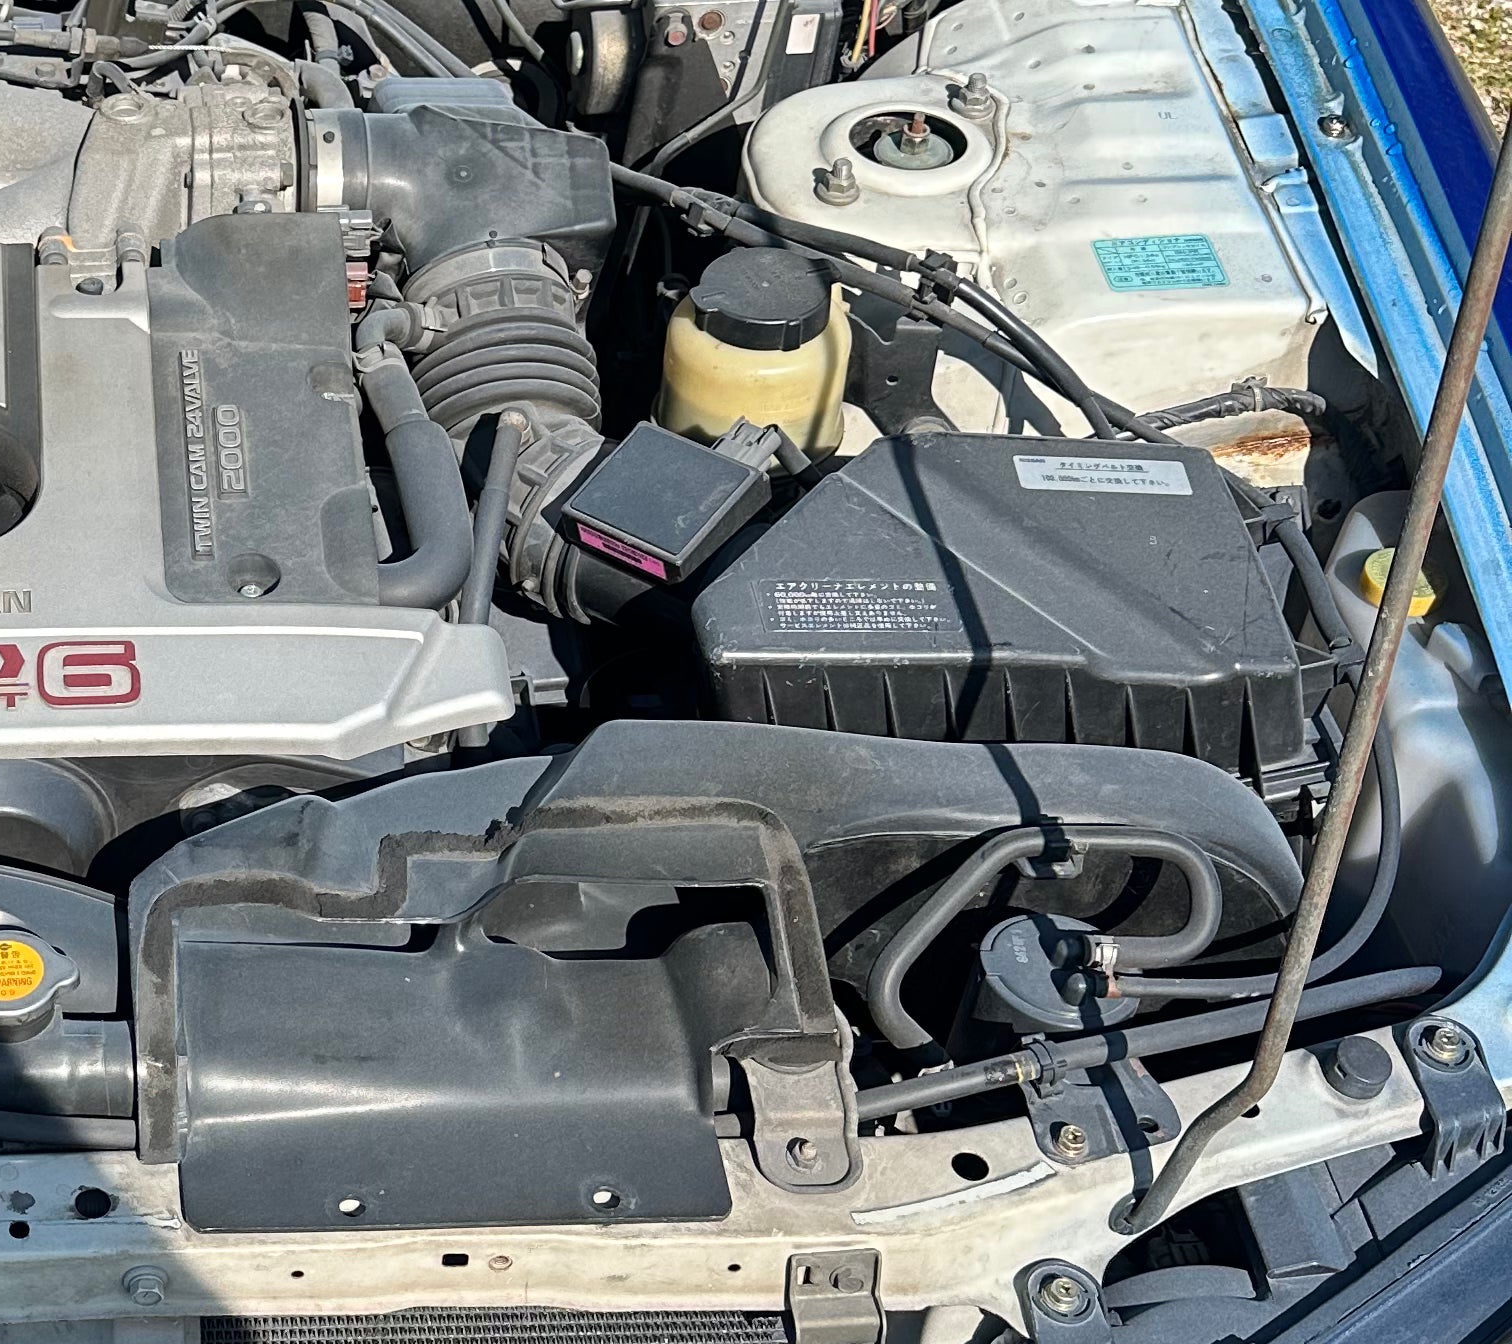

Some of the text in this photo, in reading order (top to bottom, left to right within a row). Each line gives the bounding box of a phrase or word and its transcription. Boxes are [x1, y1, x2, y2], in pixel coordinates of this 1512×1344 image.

[181, 349, 213, 553] TWIN CAM 24VALVE
[216, 404, 245, 491] 2000
[36, 640, 142, 709] 6
